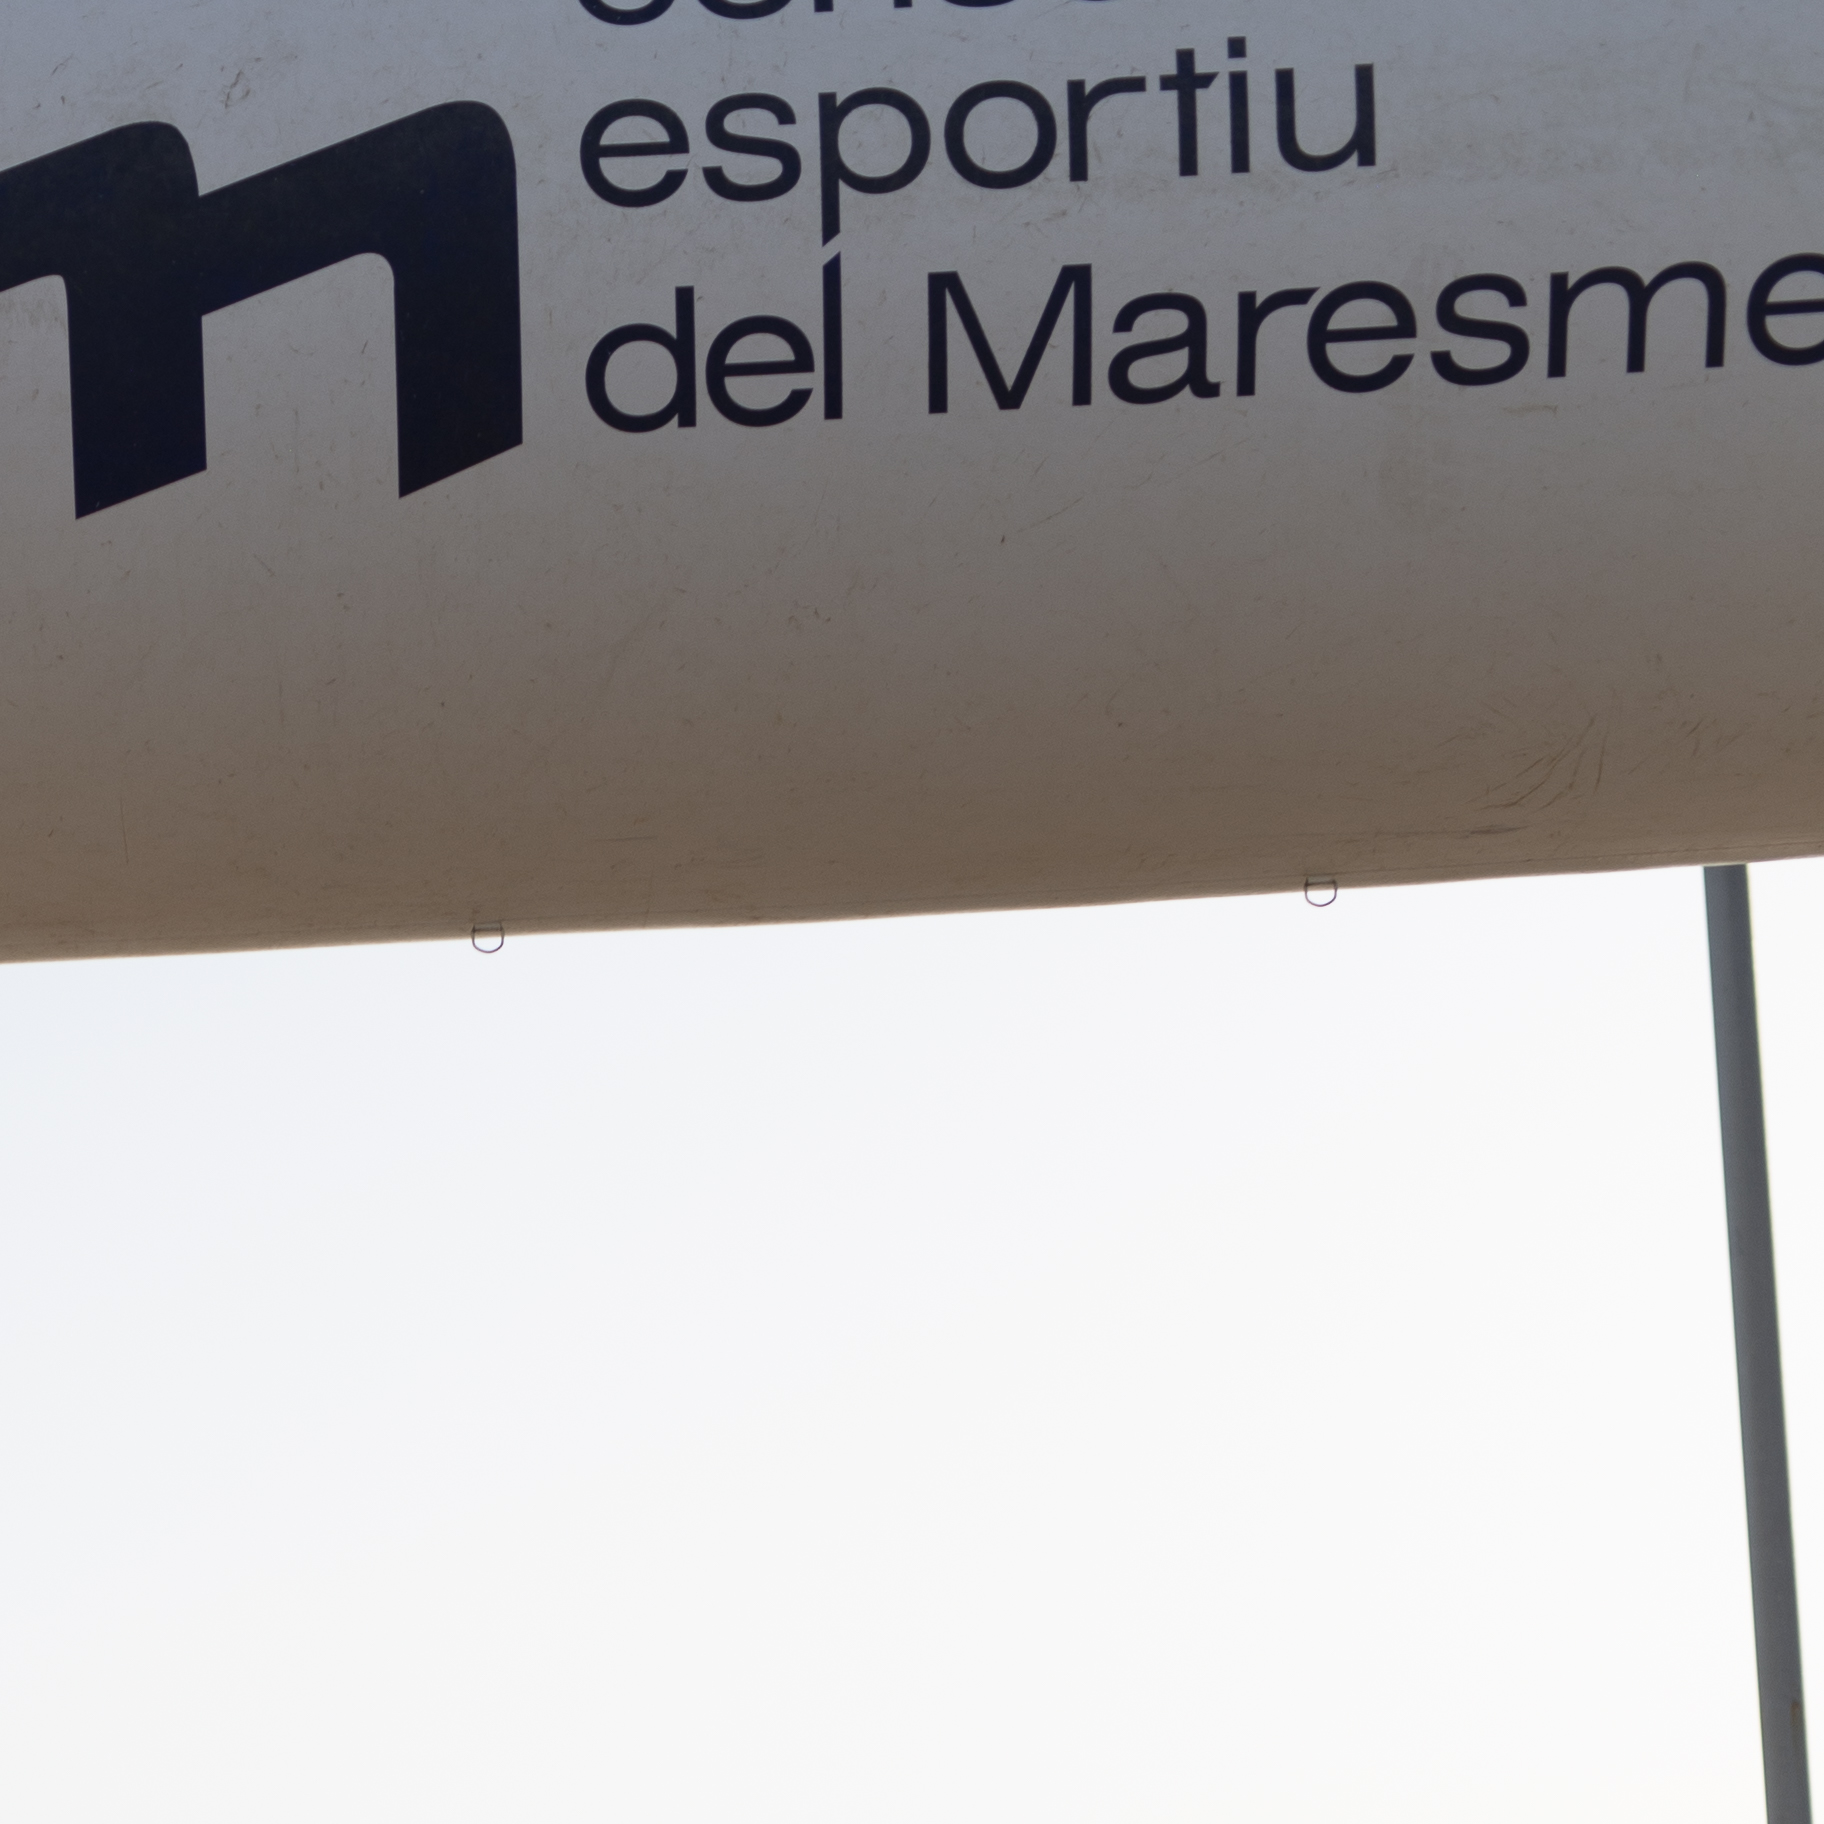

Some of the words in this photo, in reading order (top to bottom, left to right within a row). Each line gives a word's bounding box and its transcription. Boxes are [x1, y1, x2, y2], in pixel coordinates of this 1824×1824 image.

[579, 35, 1376, 247] esportiu
[585, 250, 843, 434] del
[927, 253, 1824, 415] Maresme
